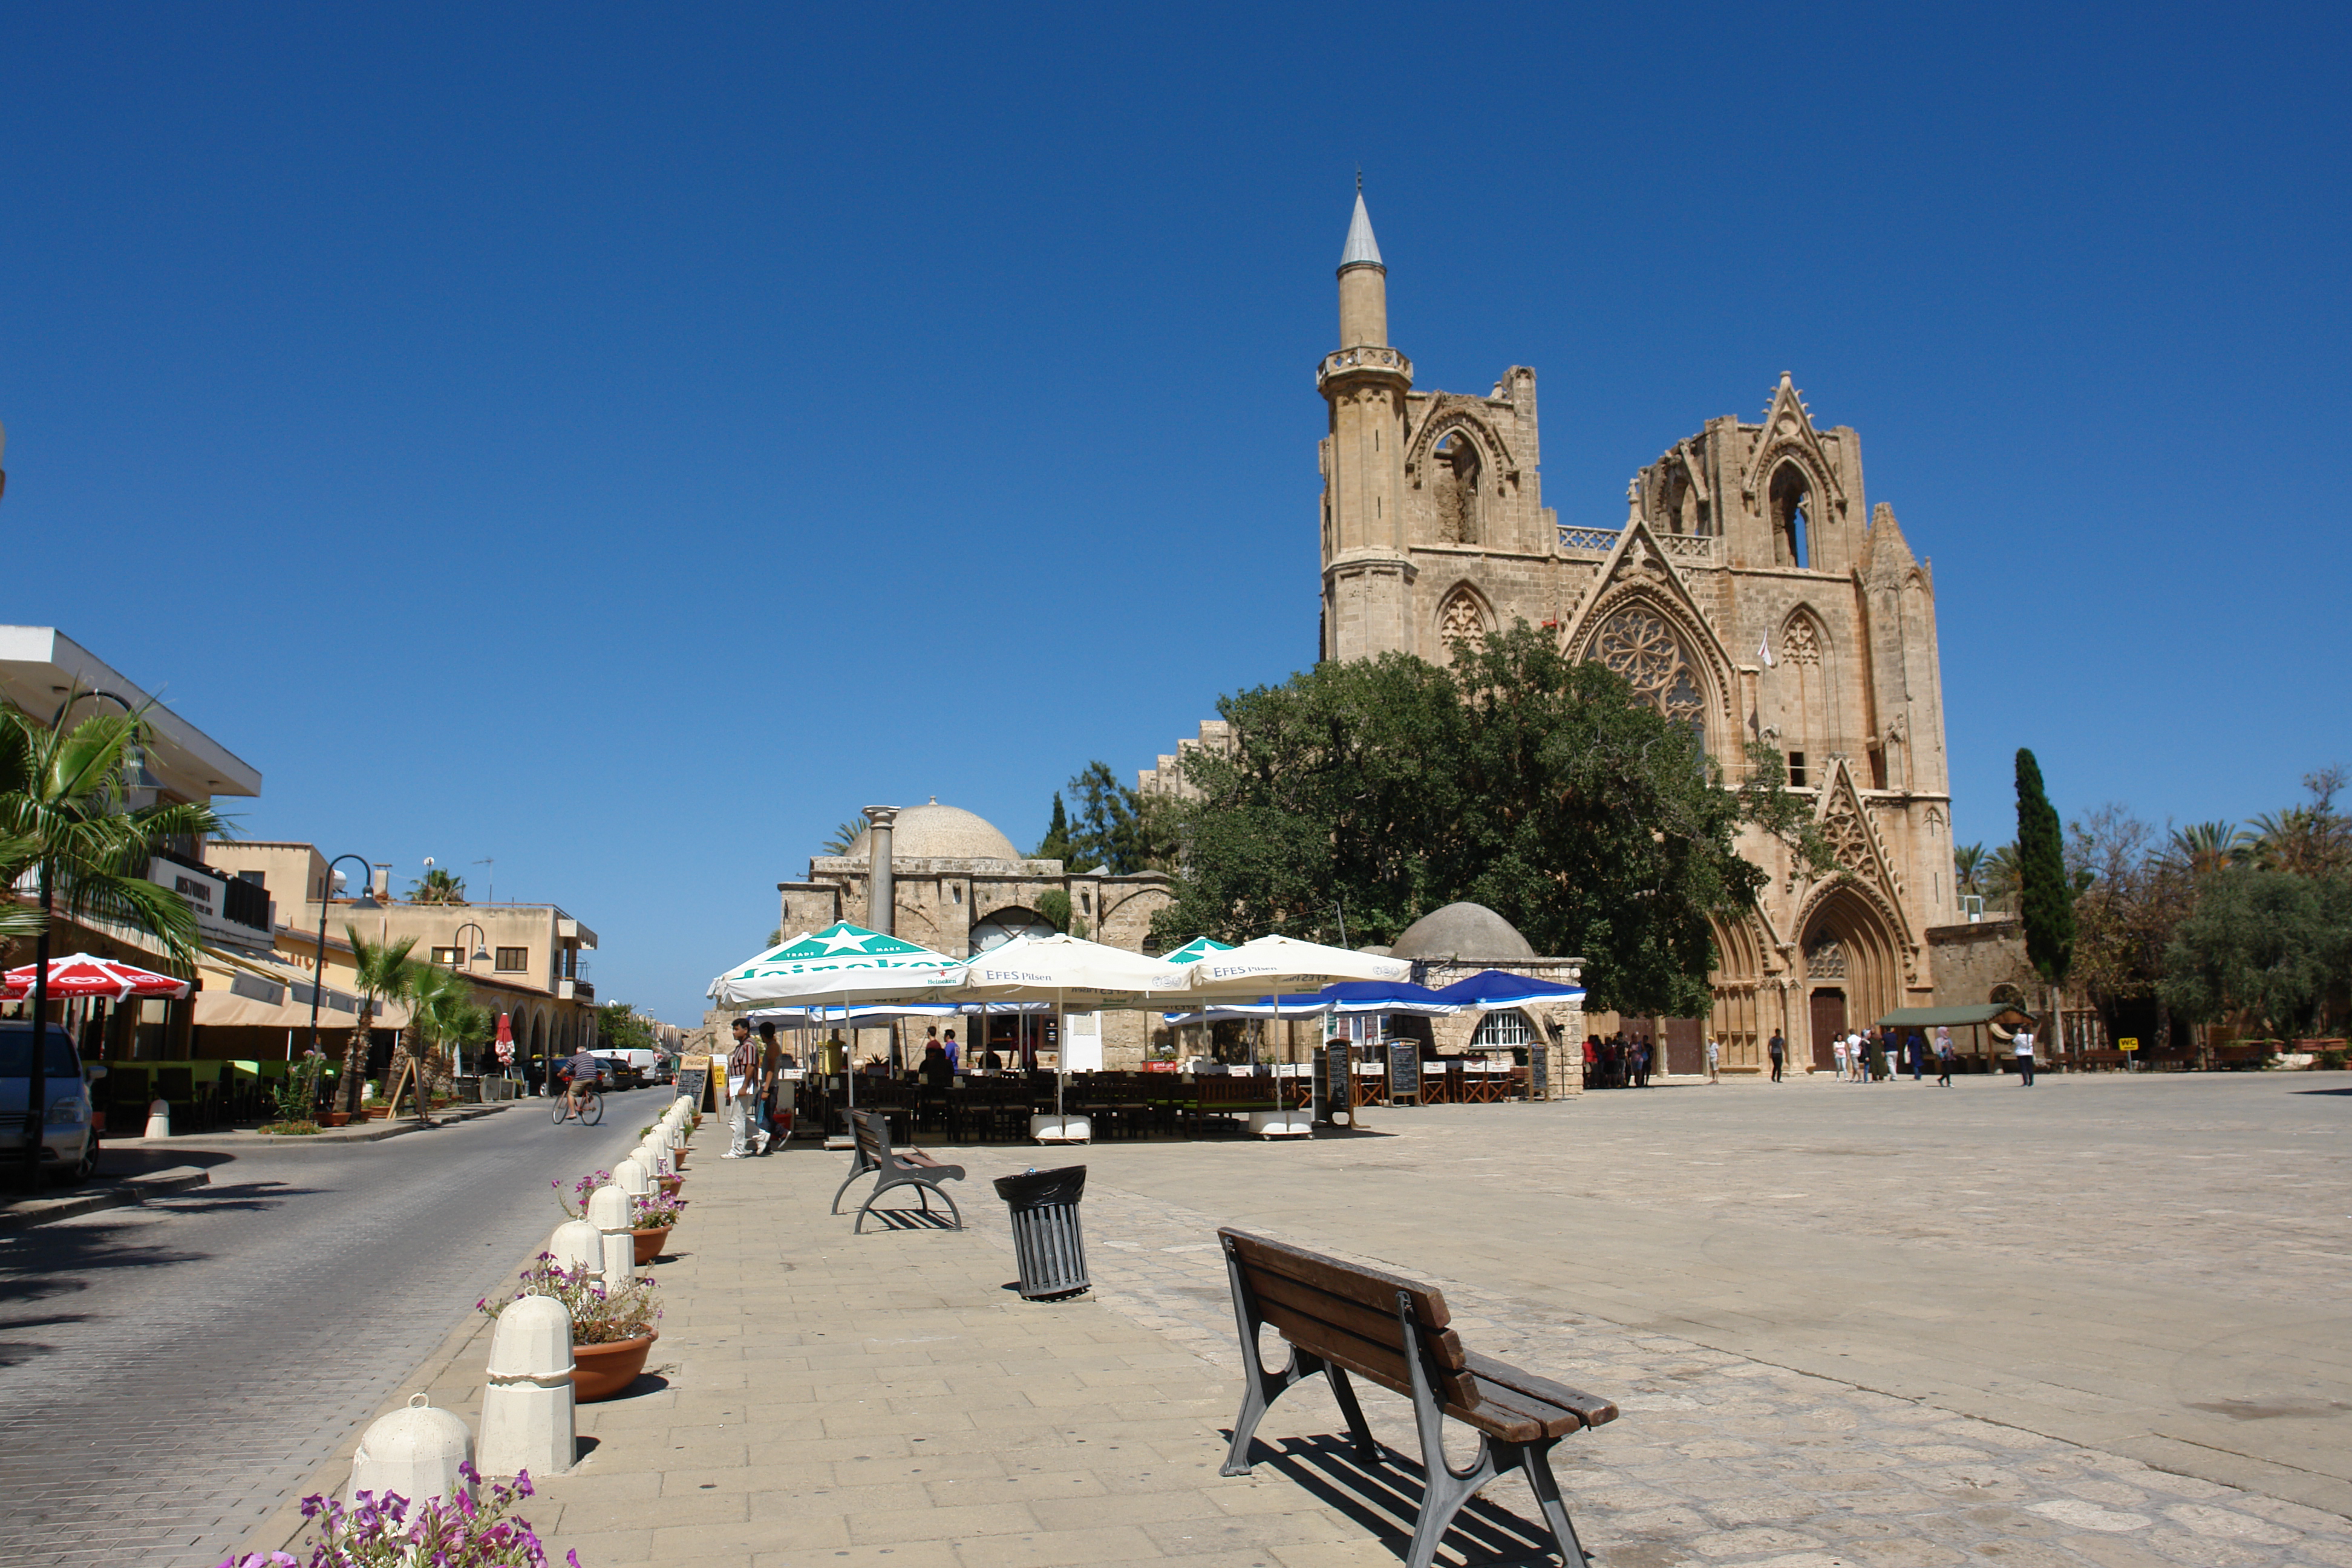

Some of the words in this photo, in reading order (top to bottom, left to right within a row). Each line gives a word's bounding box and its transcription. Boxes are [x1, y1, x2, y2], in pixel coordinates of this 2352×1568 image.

[986, 970, 1019, 980] EFES
[1022, 972, 1052, 981] Pilsen
[1214, 966, 1246, 978] EFES
